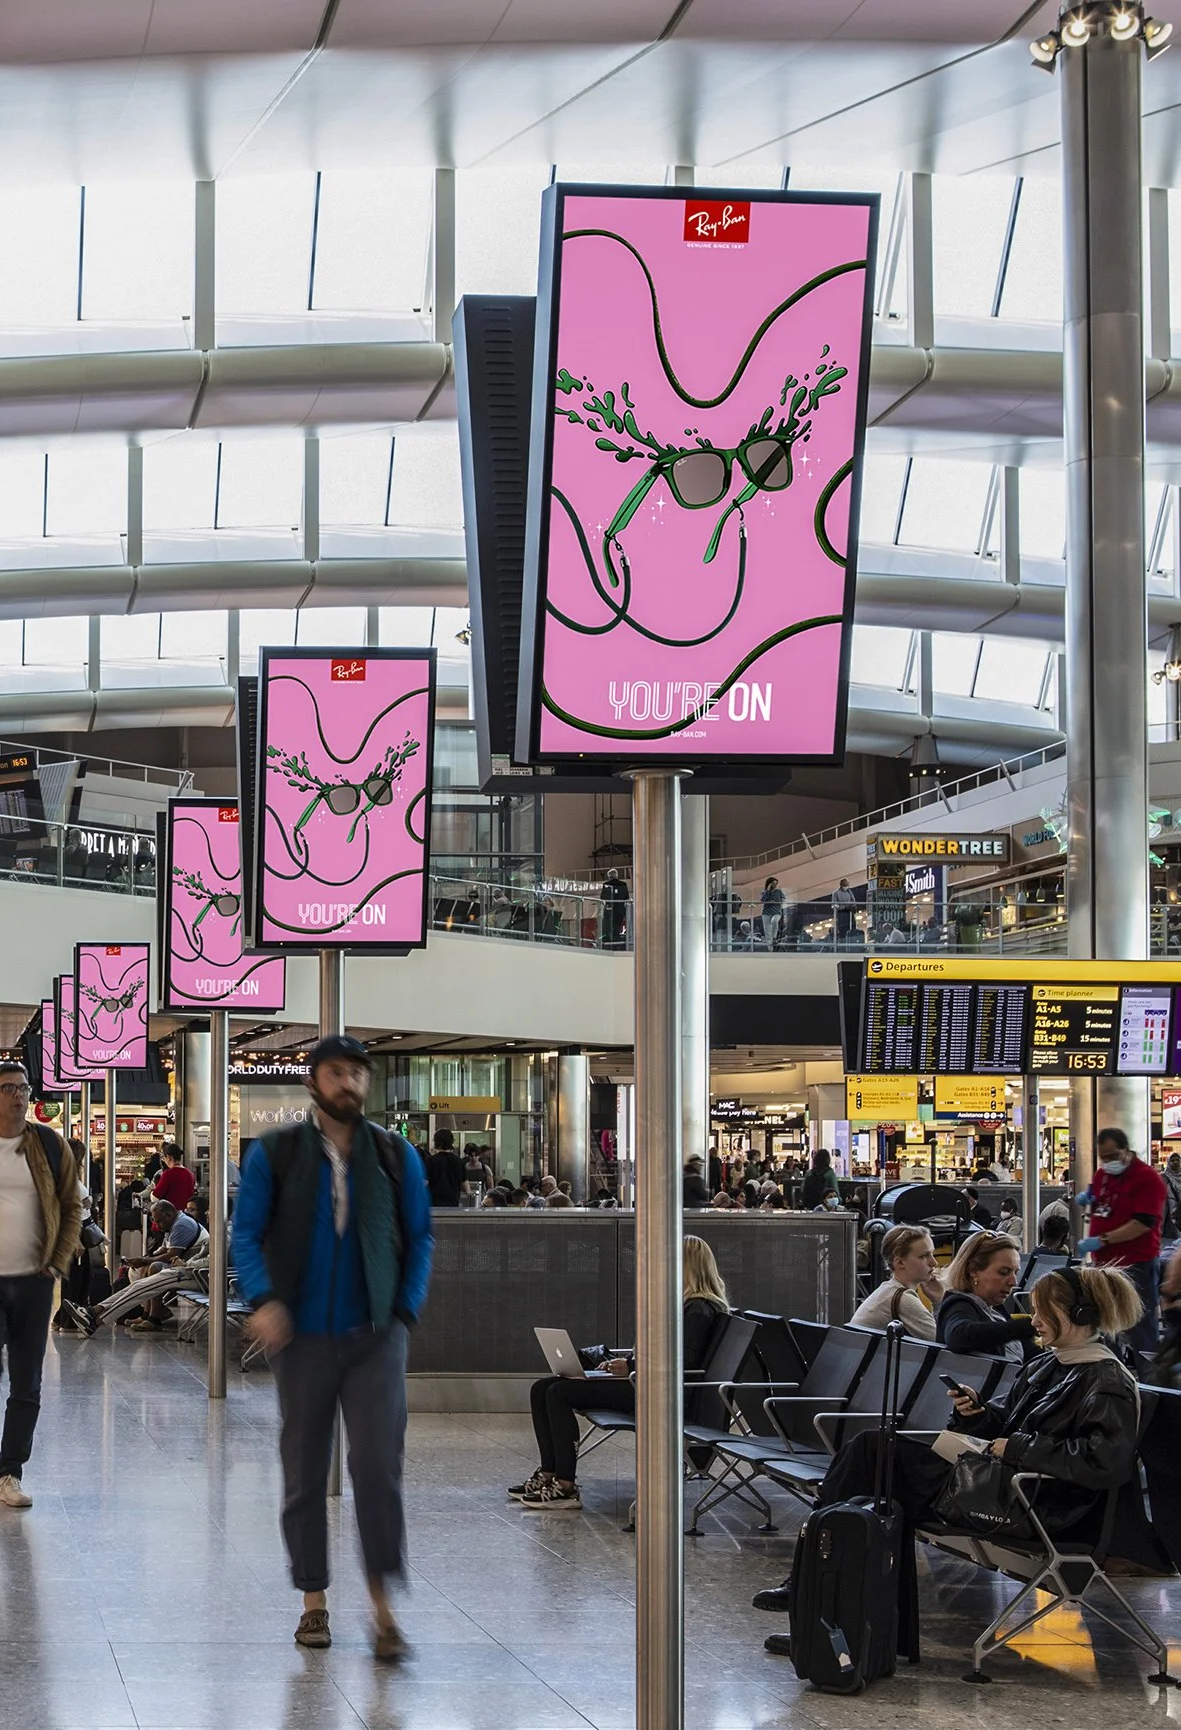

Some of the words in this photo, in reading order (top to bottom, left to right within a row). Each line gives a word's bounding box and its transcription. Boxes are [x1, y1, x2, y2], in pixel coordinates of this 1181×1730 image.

[608, 681, 720, 721] YOU'RE
[728, 682, 773, 721] ON
[882, 840, 1003, 855] WONDERTREE
[878, 878, 903, 888] FAST
[298, 903, 359, 925] YOU'RE
[362, 903, 387, 925] ON
[886, 962, 945, 973] Departures
[195, 978, 240, 995] YOU'RE
[241, 979, 259, 996] ON
[1066, 990, 1094, 998] planner
[1086, 1006, 1092, 1014] 5
[1085, 1020, 1091, 1028] 5
[1080, 1034, 1089, 1042] 15
[120, 1050, 132, 1060] ON
[1068, 1055, 1107, 1069] 16:53
[718, 1101, 735, 1109] MAC
